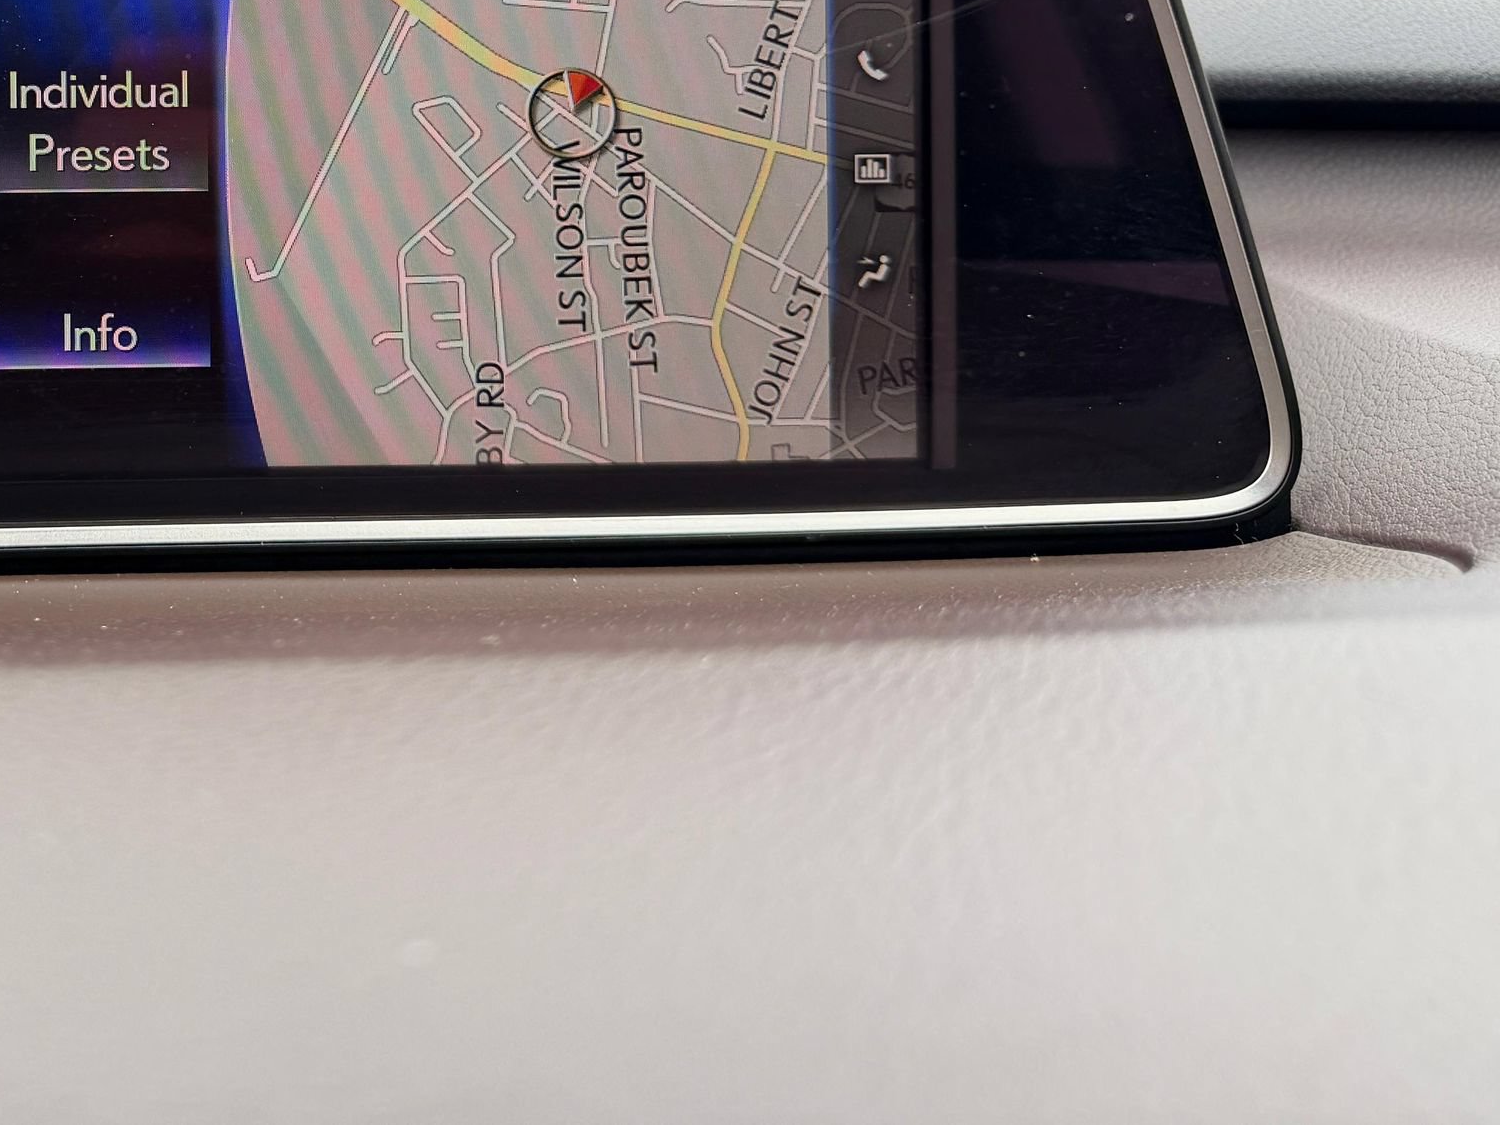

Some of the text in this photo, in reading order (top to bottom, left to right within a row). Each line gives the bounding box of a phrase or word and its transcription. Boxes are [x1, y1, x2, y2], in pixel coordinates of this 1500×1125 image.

[8, 70, 189, 109] Individual
[28, 133, 171, 172] Presets
[550, 140, 587, 332] WILSON ST
[614, 127, 658, 373] PAROUBEK ST
[63, 312, 139, 353] Info
[747, 276, 822, 425] JOHN ST
[475, 362, 505, 407] RD
